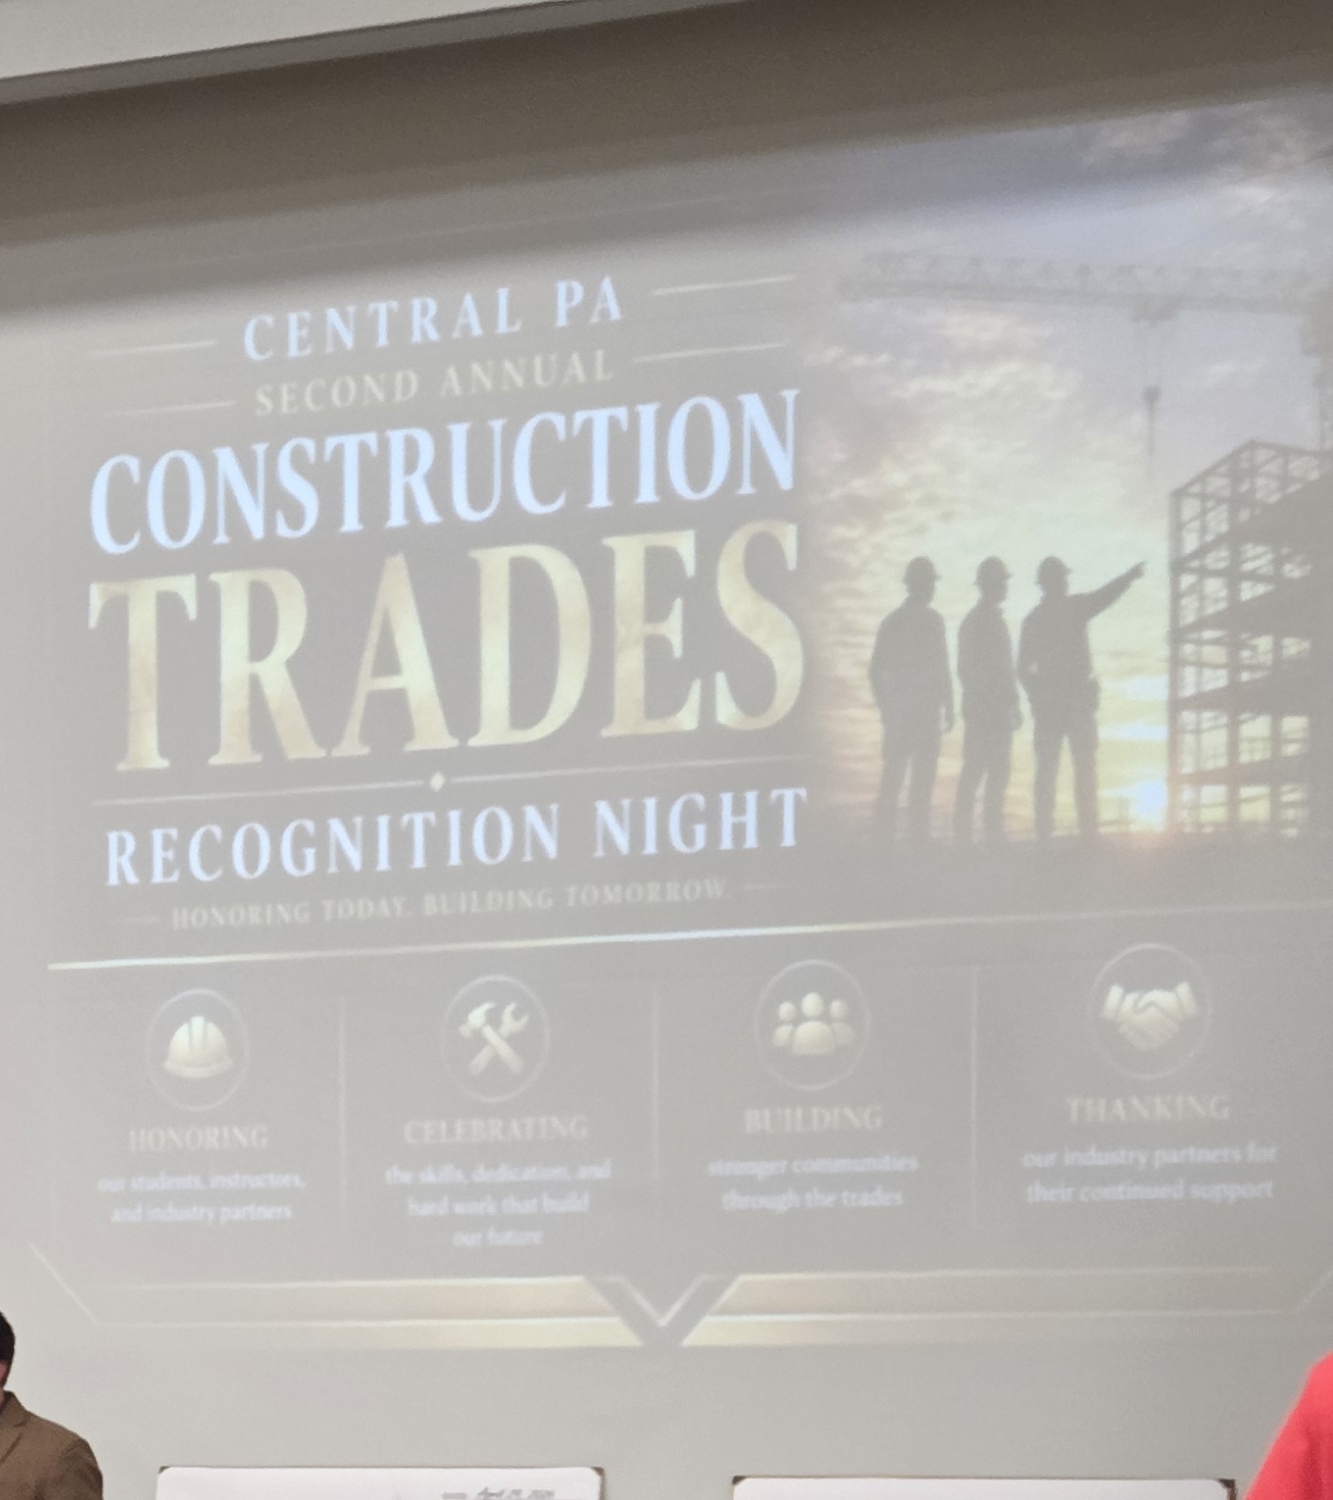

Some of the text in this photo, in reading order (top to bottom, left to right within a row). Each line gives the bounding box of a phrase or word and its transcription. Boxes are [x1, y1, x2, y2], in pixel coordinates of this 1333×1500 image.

[244, 276, 623, 361] CENTRAL PA
[255, 349, 614, 418] SECOND ANNUAL
[90, 389, 800, 556] CONSTRUCTION
[88, 519, 805, 772] TRADES
[106, 787, 808, 886] RECOGNITION NIGHT
[172, 901, 310, 930] HONORING
[423, 887, 553, 917] BUILDING
[403, 1114, 590, 1145] CELEBRATING
[743, 1102, 883, 1134] BUILDING
[1067, 1095, 1230, 1124] THANKING
[129, 1124, 268, 1153] HONORING
[1063, 1143, 1147, 1171] industry
[1153, 1146, 1242, 1169] partners
